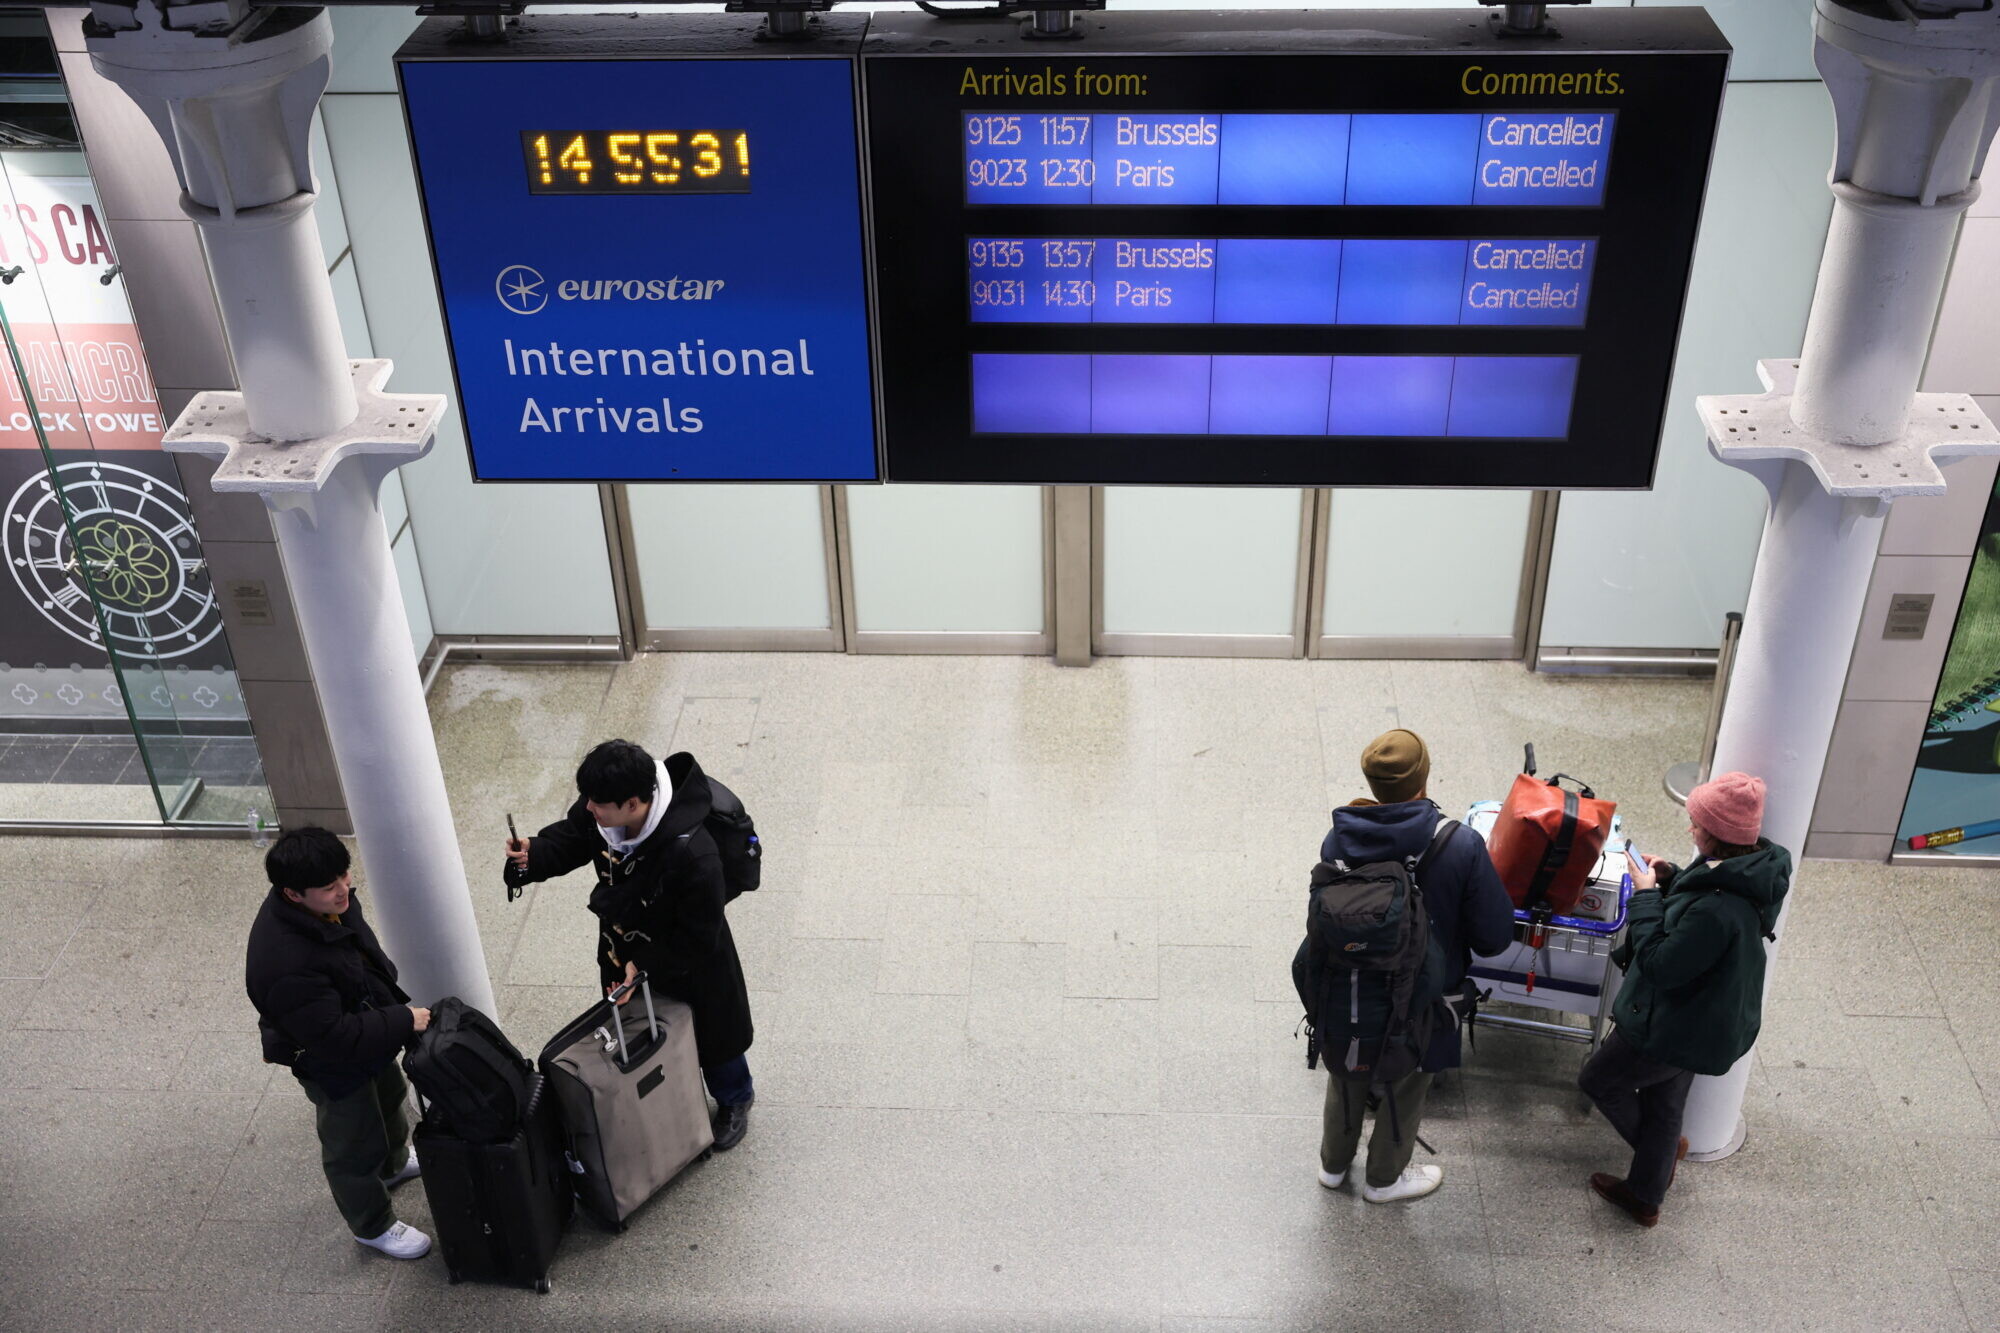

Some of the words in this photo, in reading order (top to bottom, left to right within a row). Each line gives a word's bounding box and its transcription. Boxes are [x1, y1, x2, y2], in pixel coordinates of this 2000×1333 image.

[960, 67, 1066, 95] Arrivals
[1074, 66, 1148, 95] from:
[1461, 66, 1625, 95] Comments.
[968, 117, 1022, 145] 9125
[1040, 117, 1090, 145] 11:57
[1116, 117, 1217, 145] Brussels
[1486, 117, 1603, 145] Cancelled
[969, 159, 1027, 187] 9023
[1040, 159, 1096, 187] 12:30
[1116, 159, 1175, 187] Paris
[1481, 160, 1597, 187] Cancelled
[972, 241, 1024, 267] 9135
[1042, 241, 1096, 267] 13:57
[1116, 241, 1213, 268] Brussels
[1473, 243, 1585, 269] Cancelled
[558, 275, 725, 301] eurostar
[974, 280, 1025, 305] 9031
[1042, 280, 1096, 306] 14:30
[1116, 281, 1172, 307] Paris
[1468, 282, 1578, 308] Cancelled
[505, 340, 814, 376] International
[519, 398, 703, 433] Arrivals
